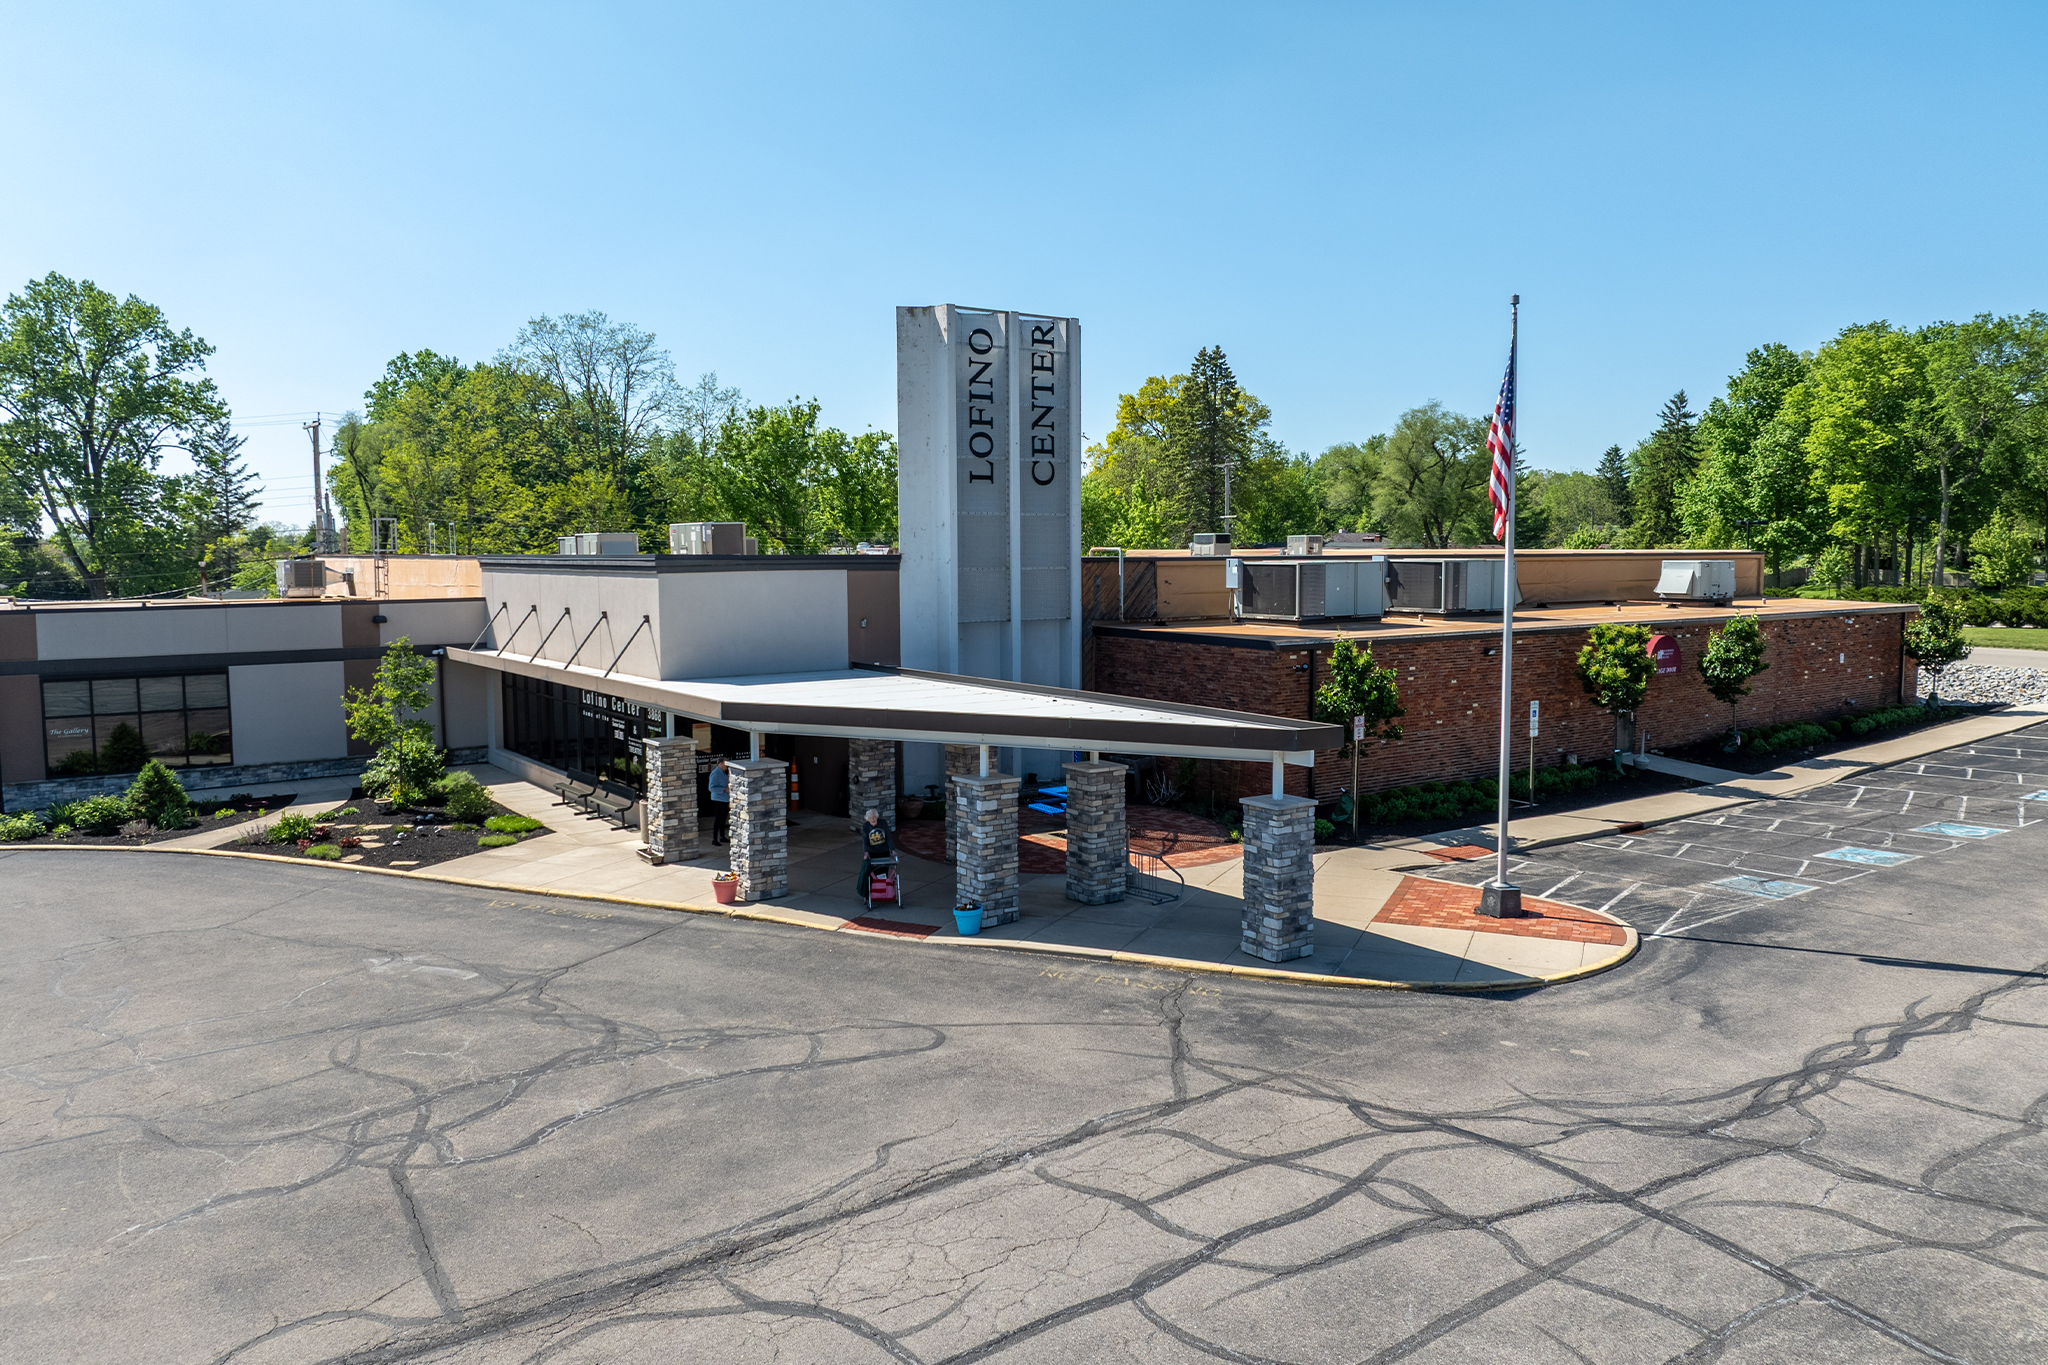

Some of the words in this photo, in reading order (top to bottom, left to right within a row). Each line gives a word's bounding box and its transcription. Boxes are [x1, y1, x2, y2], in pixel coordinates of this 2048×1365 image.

[968, 327, 994, 485] LOFINO
[1031, 321, 1055, 486] CENTER
[582, 690, 607, 708] Lofino
[611, 696, 640, 717] Center
[647, 707, 661, 722] 3868
[63, 727, 89, 735] Gallery
[633, 725, 637, 734] &
